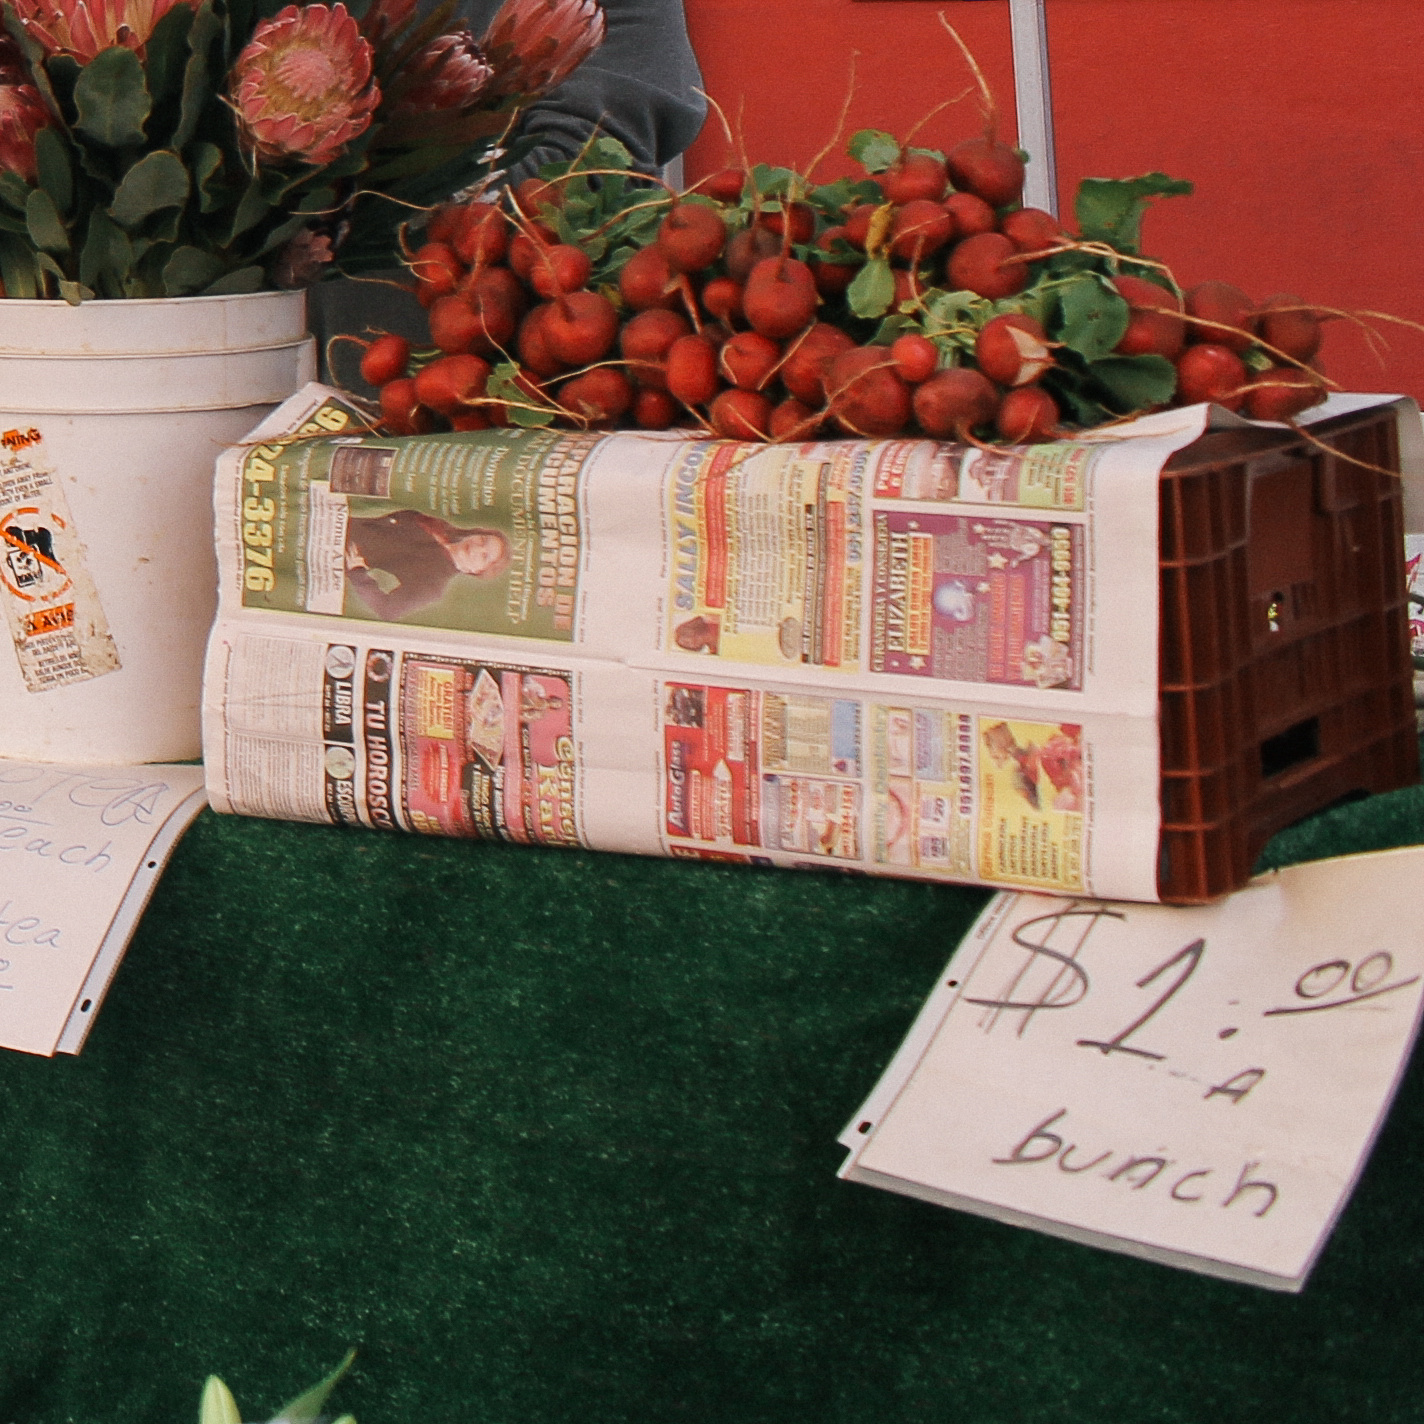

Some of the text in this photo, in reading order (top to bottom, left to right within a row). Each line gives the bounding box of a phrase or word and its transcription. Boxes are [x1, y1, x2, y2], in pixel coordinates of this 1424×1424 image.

[675, 521, 697, 611] SALLY
[887, 532, 908, 652] ELIZABETH
[874, 596, 889, 672] CURANDERA
[335, 681, 353, 724] LIBRA
[366, 700, 386, 730] TU
[667, 740, 685, 830] AutoGlass
[990, 1107, 1279, 1217] bunch
